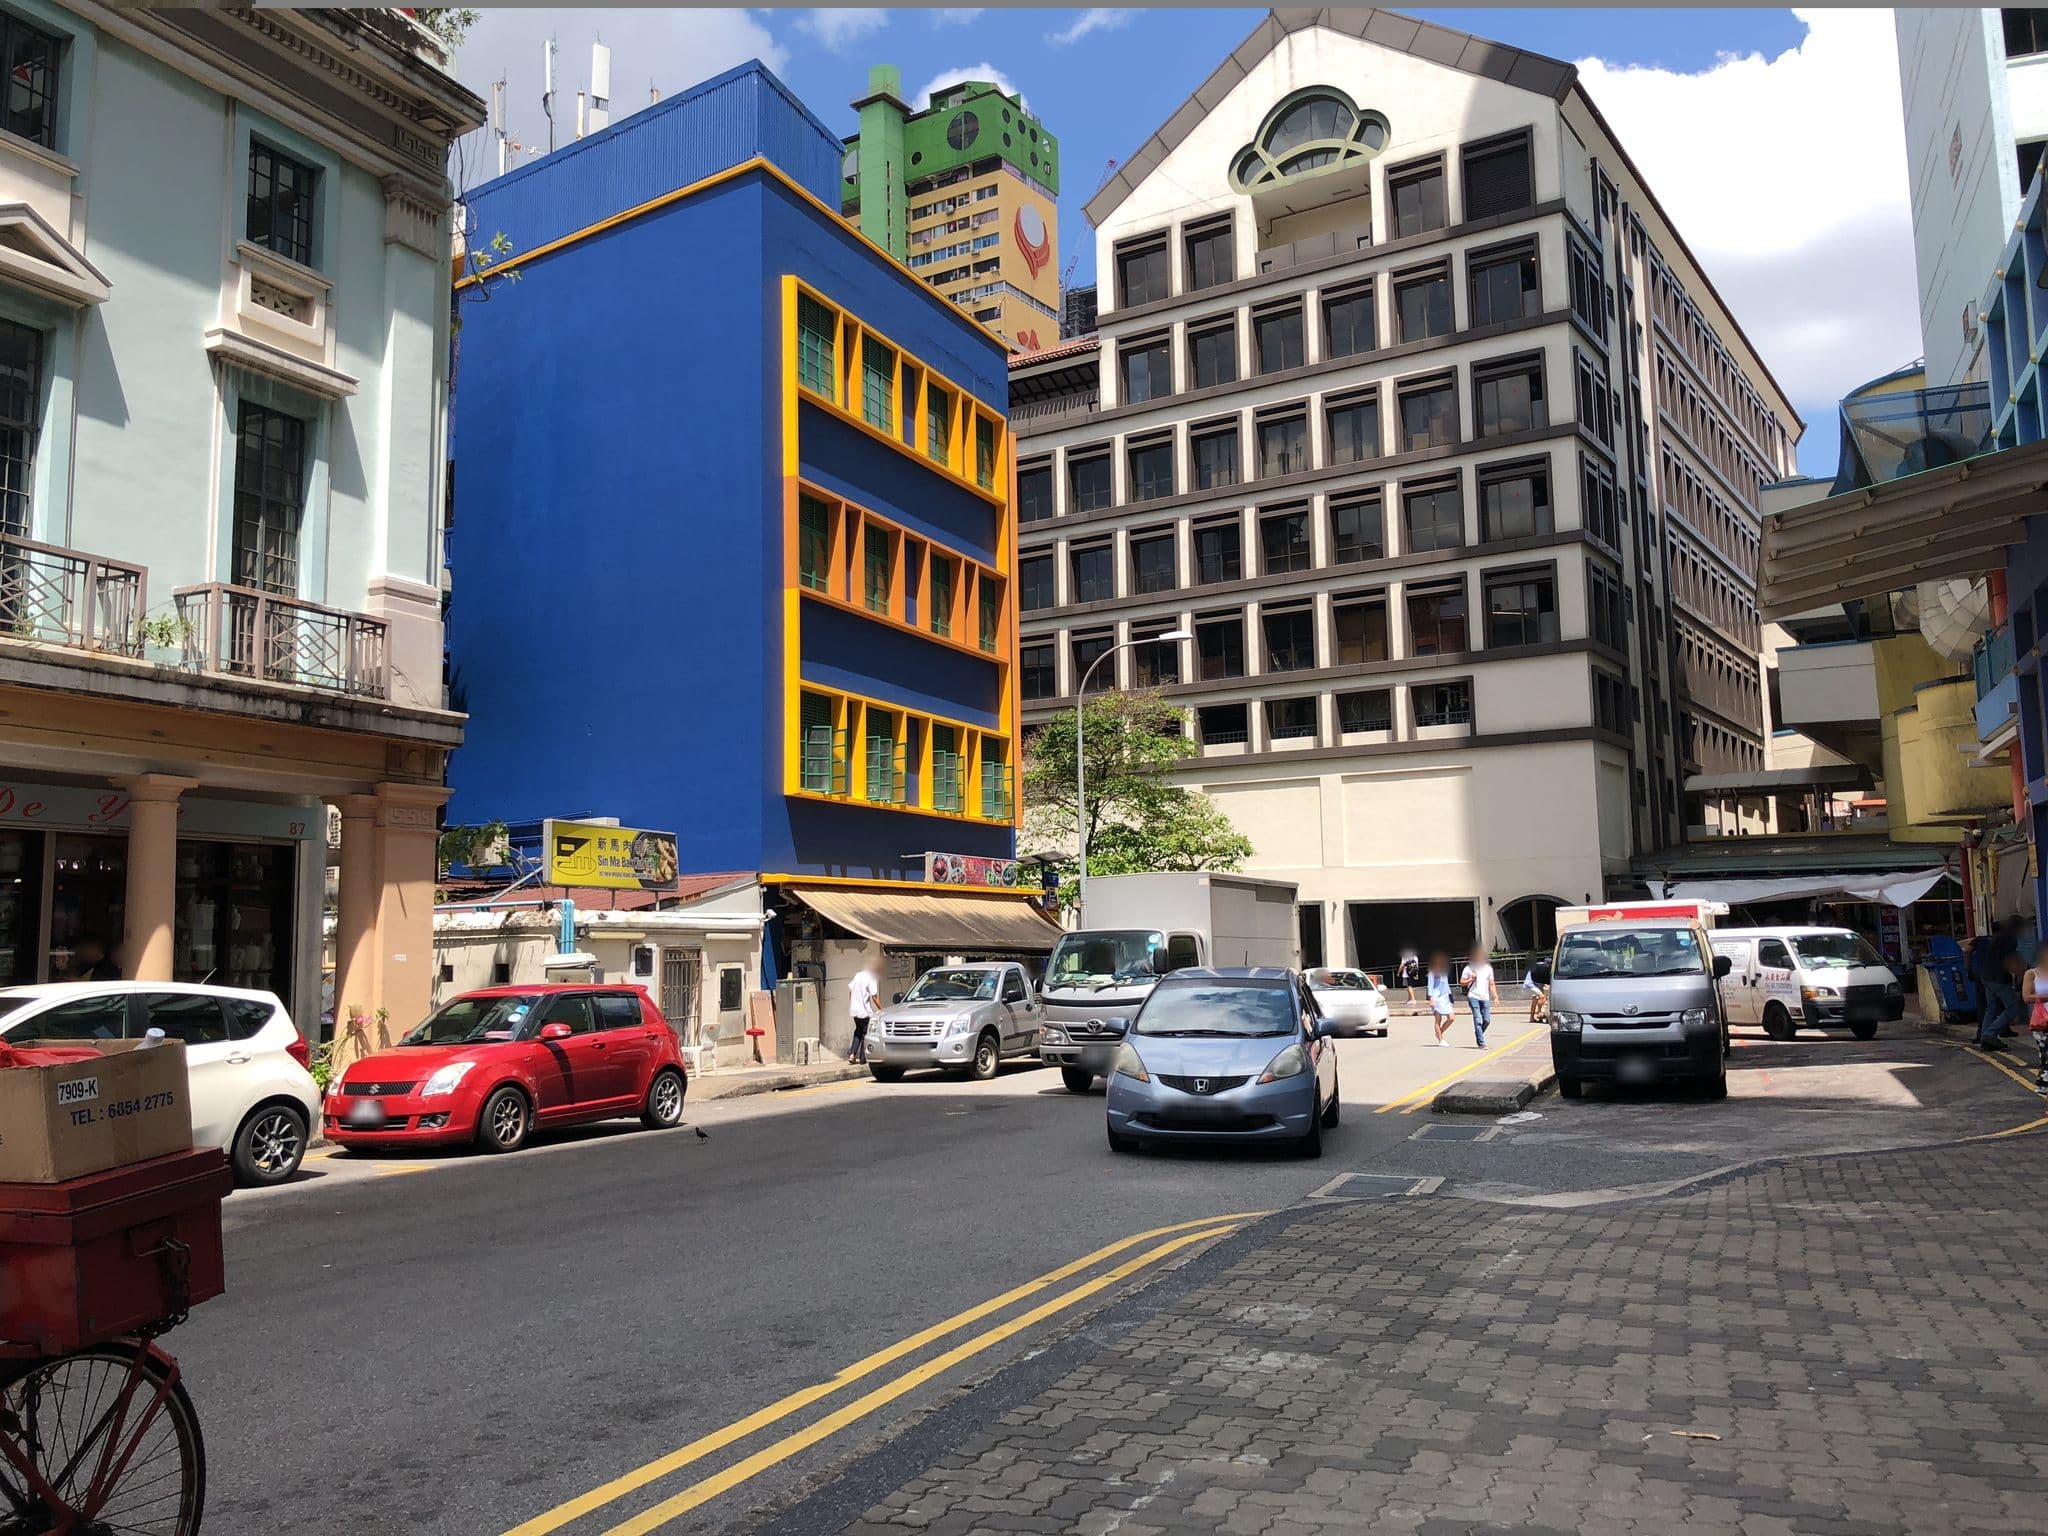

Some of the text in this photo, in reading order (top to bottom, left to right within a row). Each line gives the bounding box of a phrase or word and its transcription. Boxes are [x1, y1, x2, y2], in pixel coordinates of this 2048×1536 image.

[289, 822, 306, 835] 87
[597, 855, 609, 867] Sin
[610, 856, 621, 867] Ma
[58, 1079, 97, 1102] 7909-K
[70, 1108, 96, 1127] TEL
[144, 1091, 174, 1112] 2775
